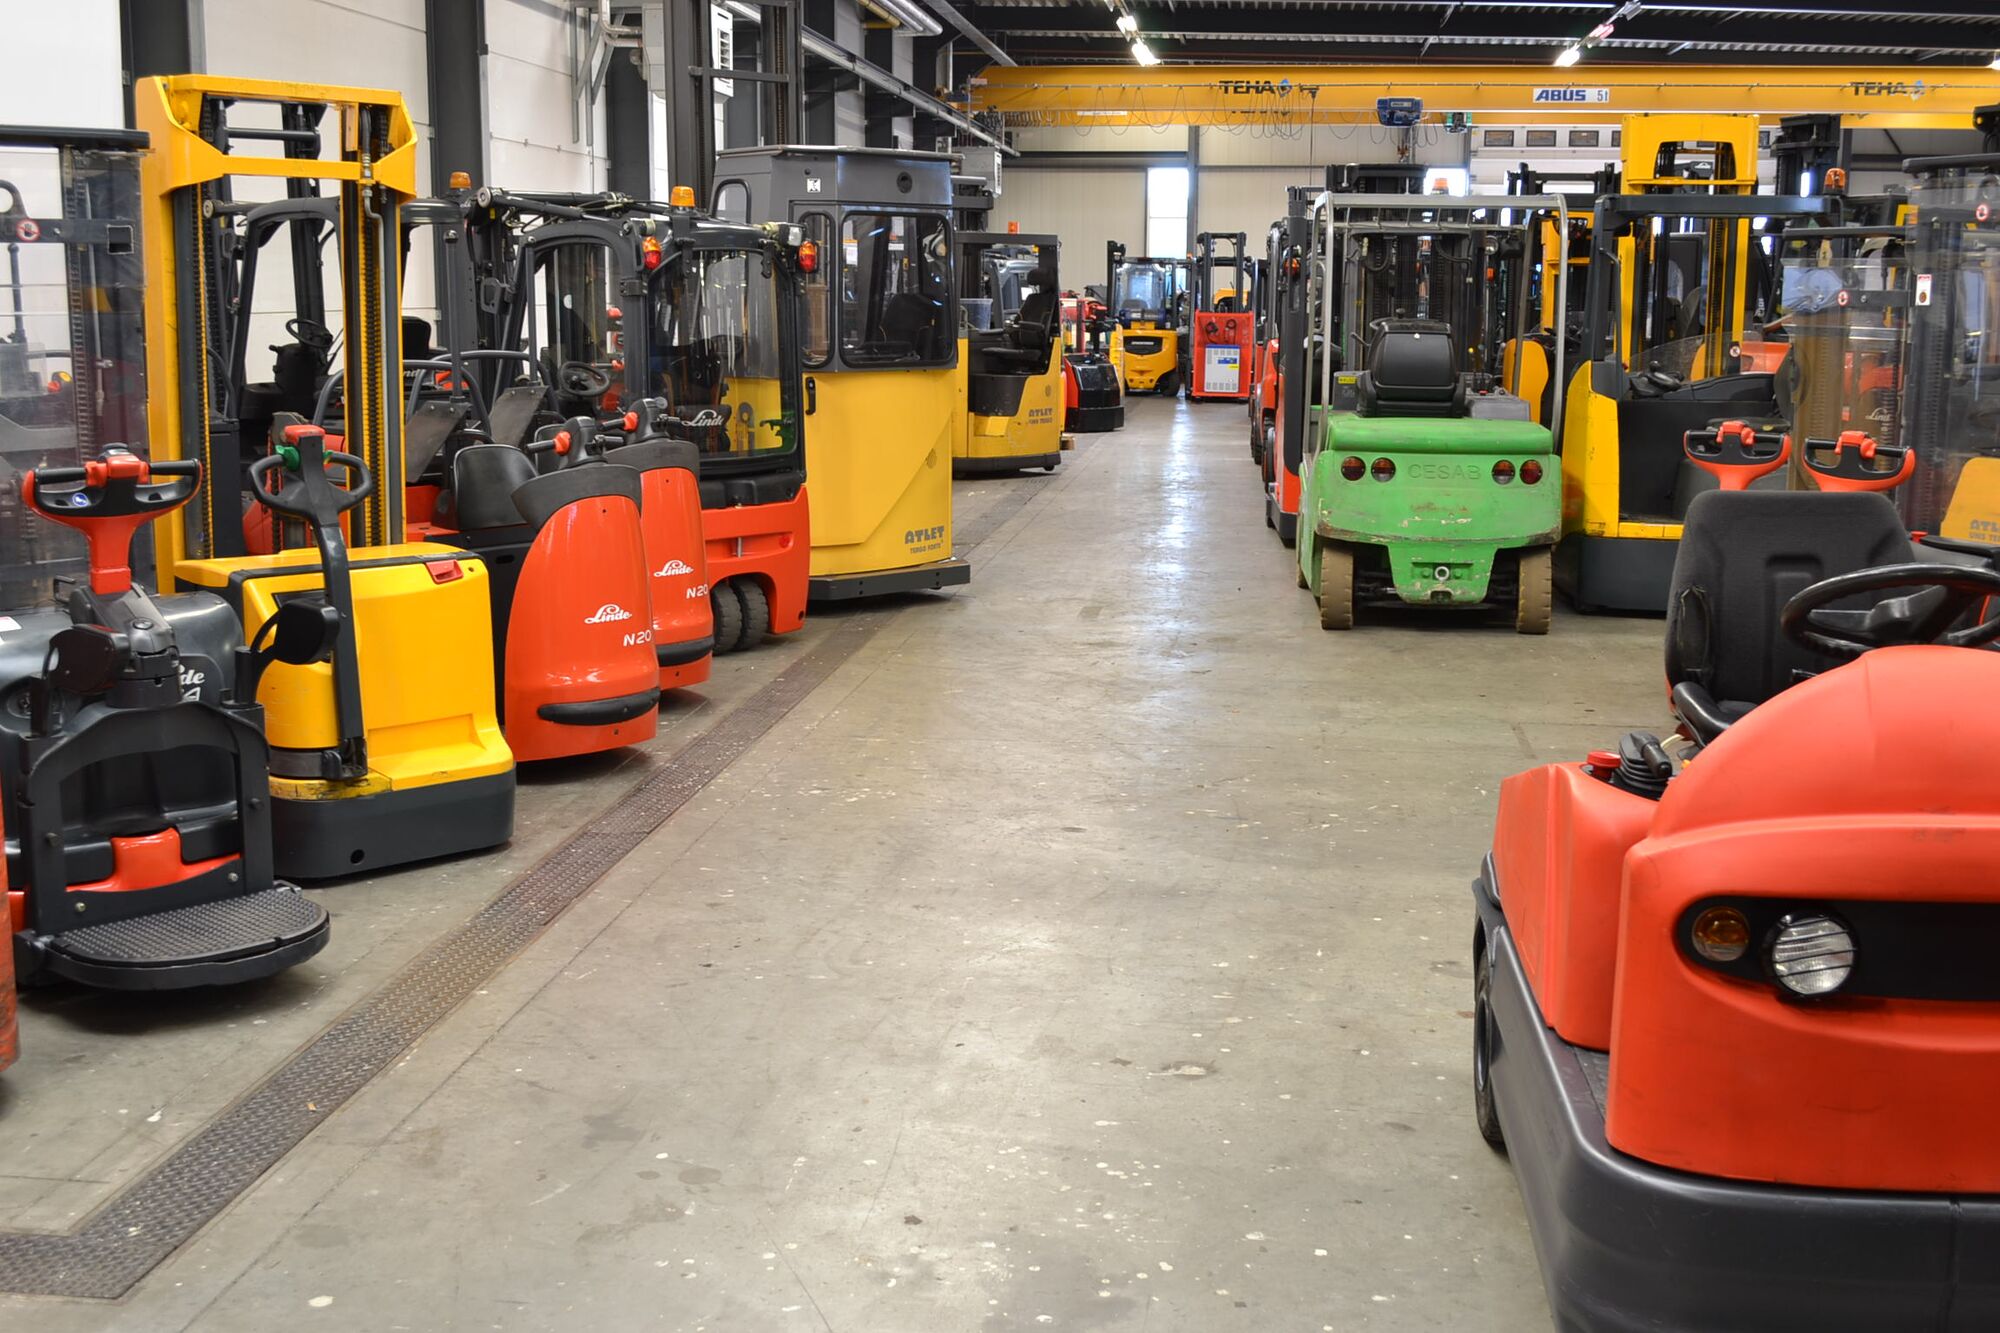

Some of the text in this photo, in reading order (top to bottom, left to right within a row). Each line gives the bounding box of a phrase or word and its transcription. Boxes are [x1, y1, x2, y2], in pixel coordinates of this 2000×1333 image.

[1219, 80, 1276, 95] TEHA
[1535, 89, 1608, 102] ABUS 5t
[1850, 81, 1908, 96] TEHA
[1865, 407, 1891, 422] Lind
[1407, 463, 1481, 480] CESAB
[904, 525, 945, 544] ATLET
[653, 559, 694, 577] Linde
[584, 603, 633, 624] Linde
